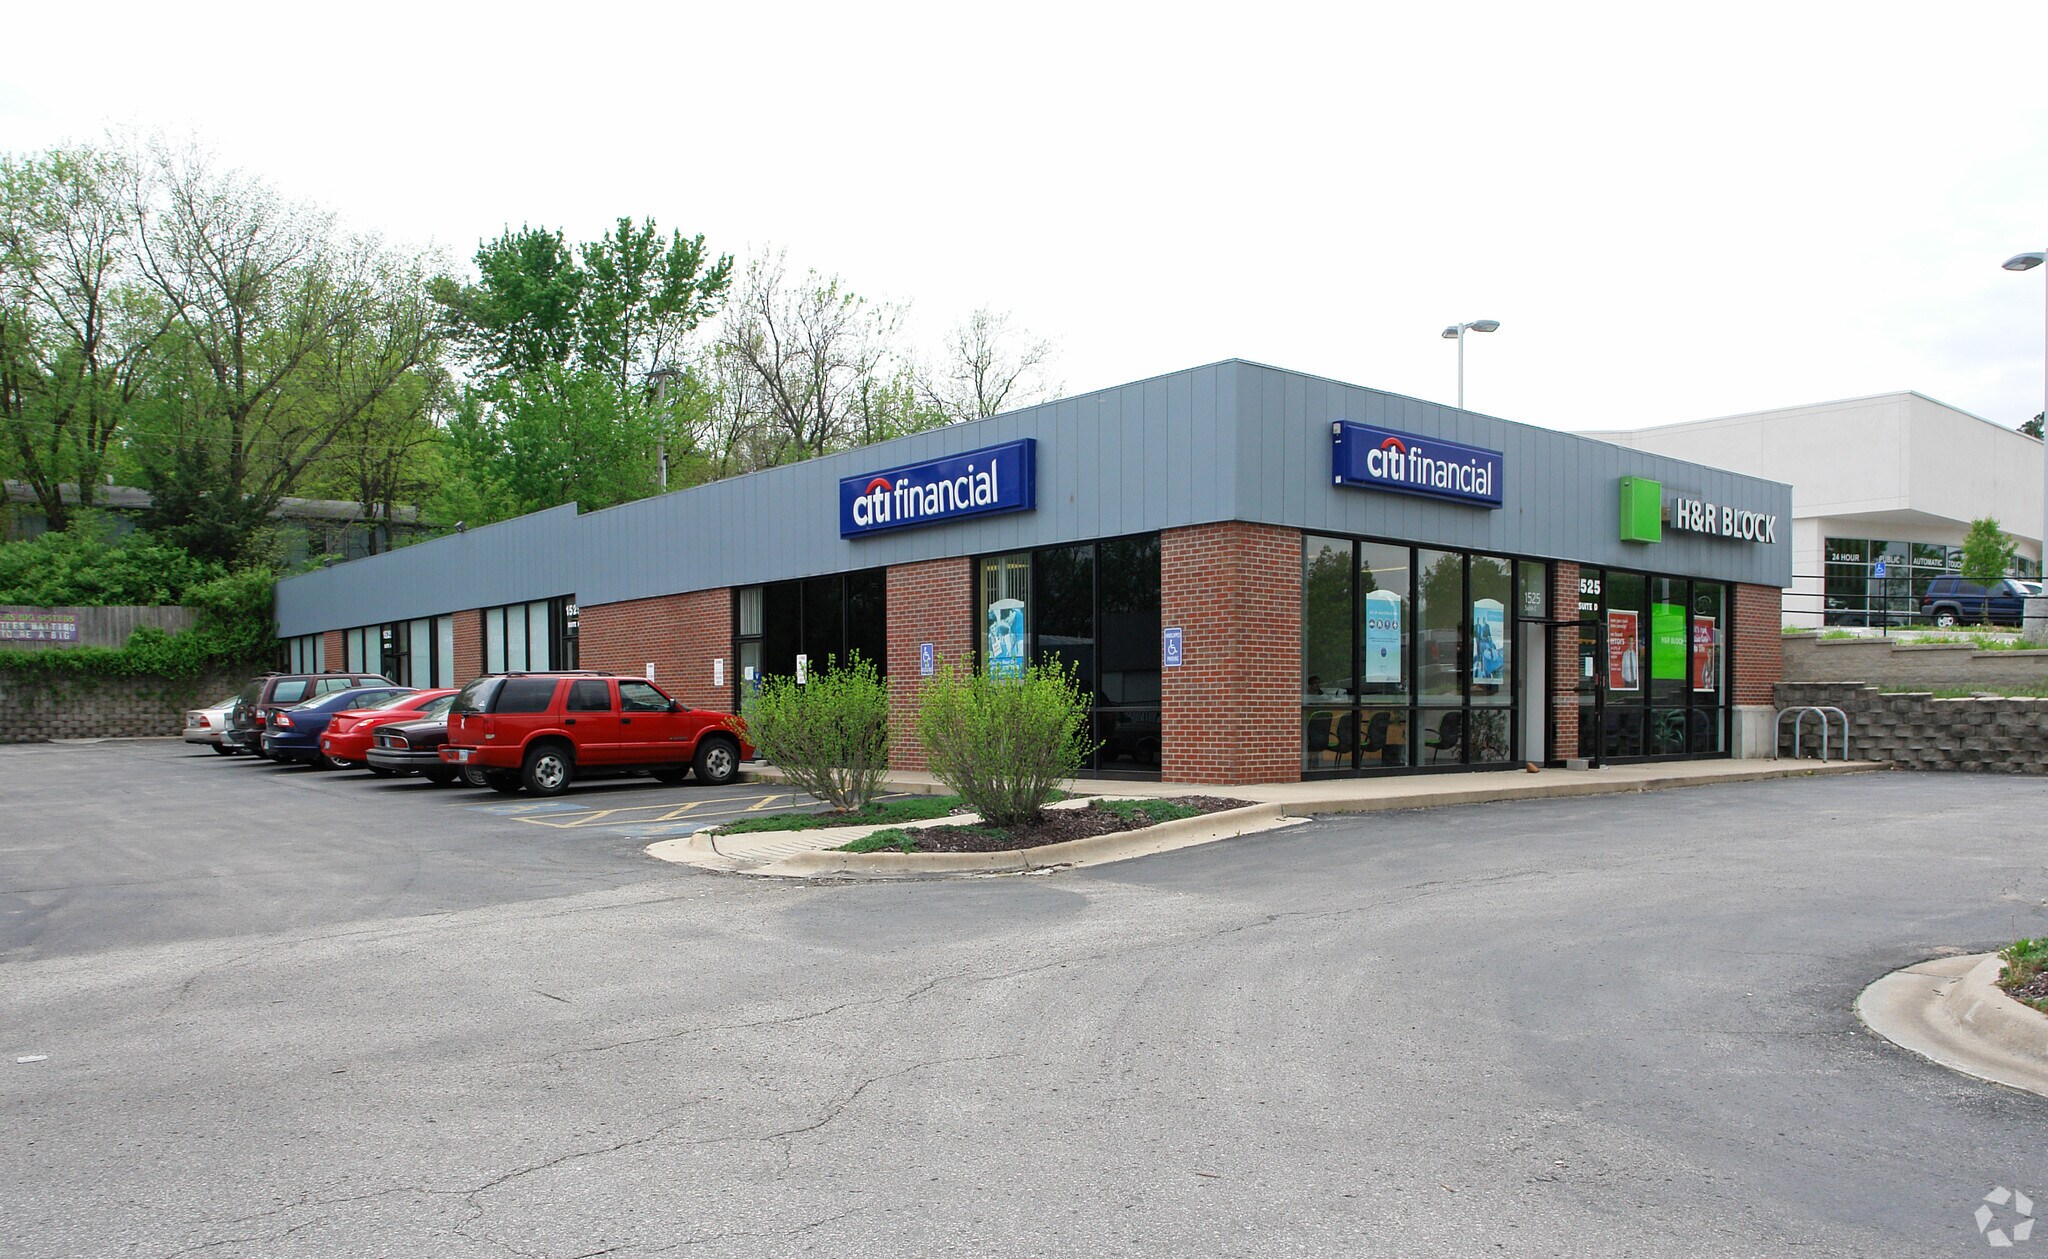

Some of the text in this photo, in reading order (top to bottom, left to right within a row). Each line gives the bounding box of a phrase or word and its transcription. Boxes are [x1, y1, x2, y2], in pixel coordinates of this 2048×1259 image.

[1677, 498, 1776, 543] H&R BLOCK
[1832, 553, 1839, 561] 24
[1841, 553, 1860, 562] HOUR
[1879, 555, 1900, 564] PUBLIC
[1913, 557, 1943, 567] AUTOMATIC
[1578, 578, 1601, 595] 525
[1524, 592, 1541, 605] 1525
[1578, 602, 1599, 611] SUITE D
[18, 613, 35, 621] BIG
[37, 614, 75, 623] SISTERS
[31, 622, 76, 632] WAITING
[19, 630, 33, 639] BE
[39, 631, 45, 639] A
[51, 632, 70, 640] BIG
